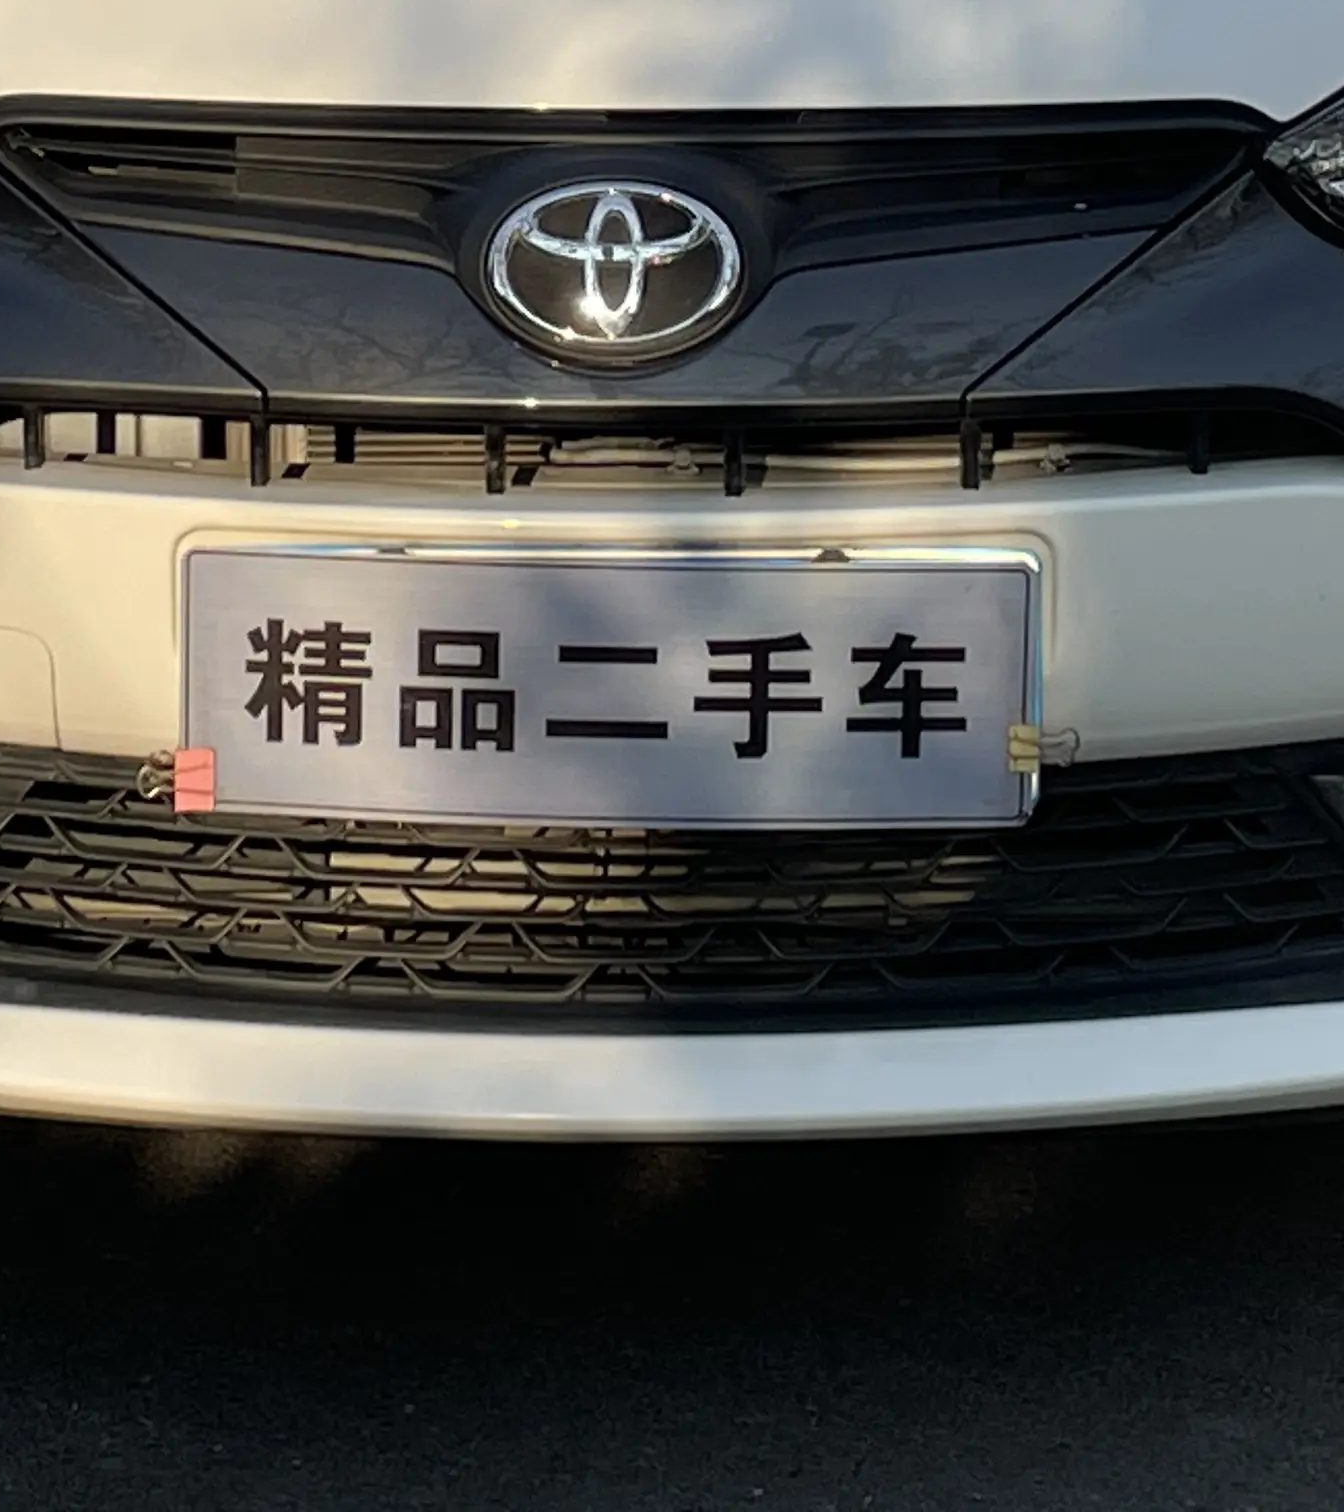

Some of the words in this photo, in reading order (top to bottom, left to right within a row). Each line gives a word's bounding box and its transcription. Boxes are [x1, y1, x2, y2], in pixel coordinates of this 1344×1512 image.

[244, 617, 968, 760] 精品二手车
